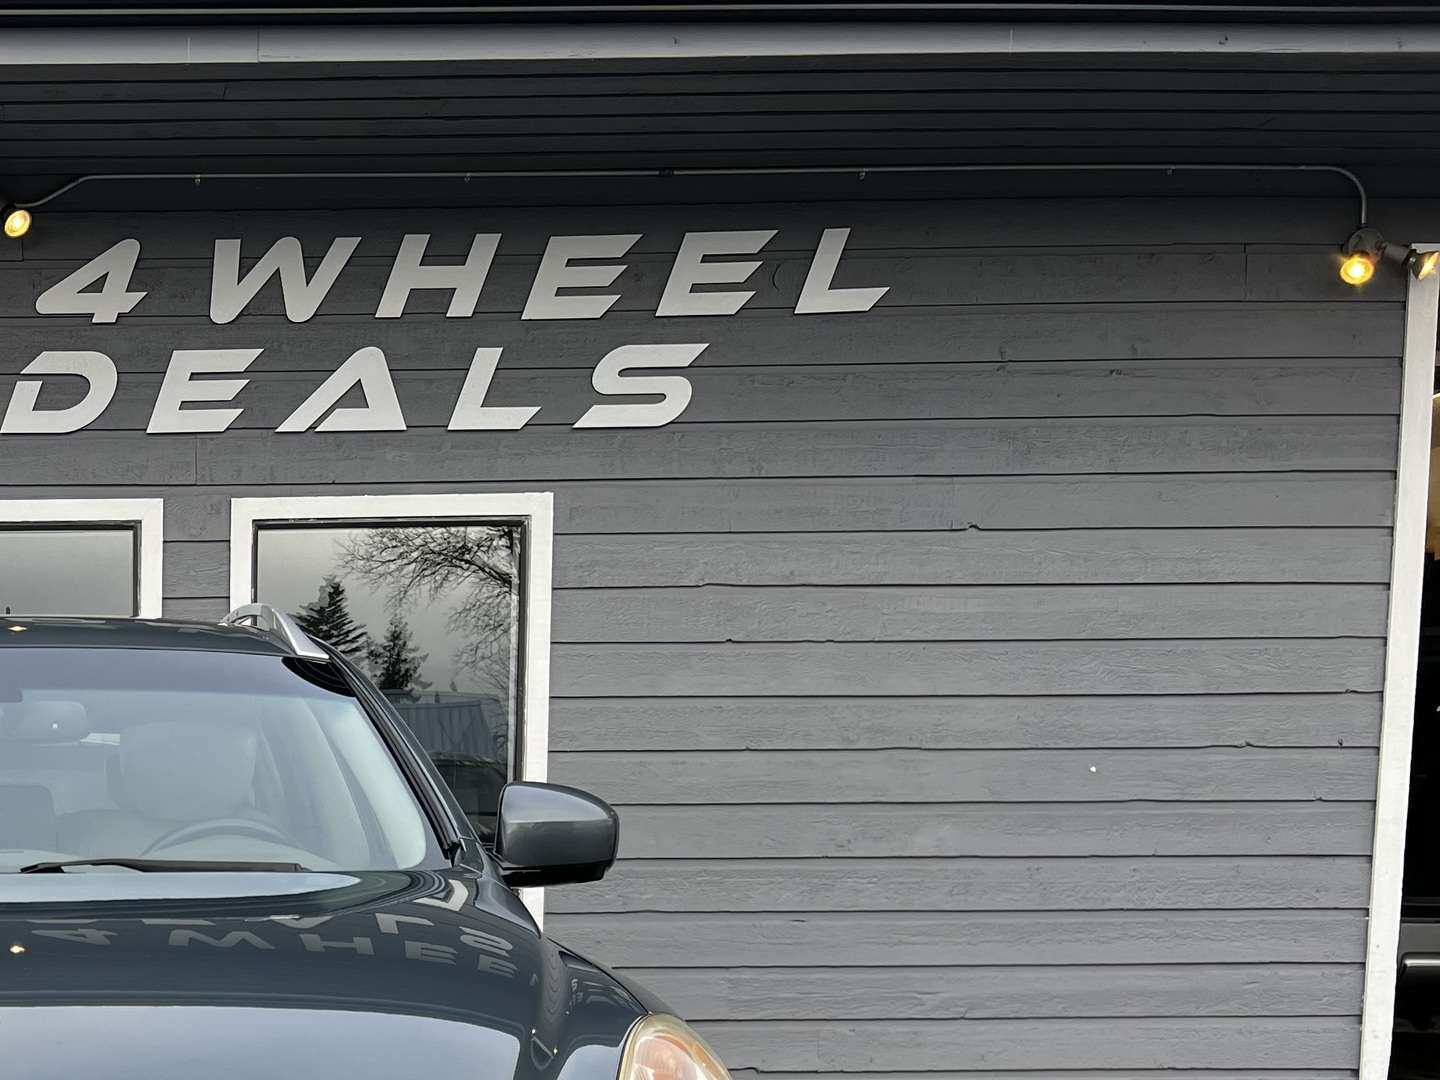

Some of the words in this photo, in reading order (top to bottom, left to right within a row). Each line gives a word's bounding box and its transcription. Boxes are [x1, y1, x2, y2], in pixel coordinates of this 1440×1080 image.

[35, 238, 148, 323] 4
[211, 228, 891, 323] WHEEL
[0, 343, 710, 434] DEALS
